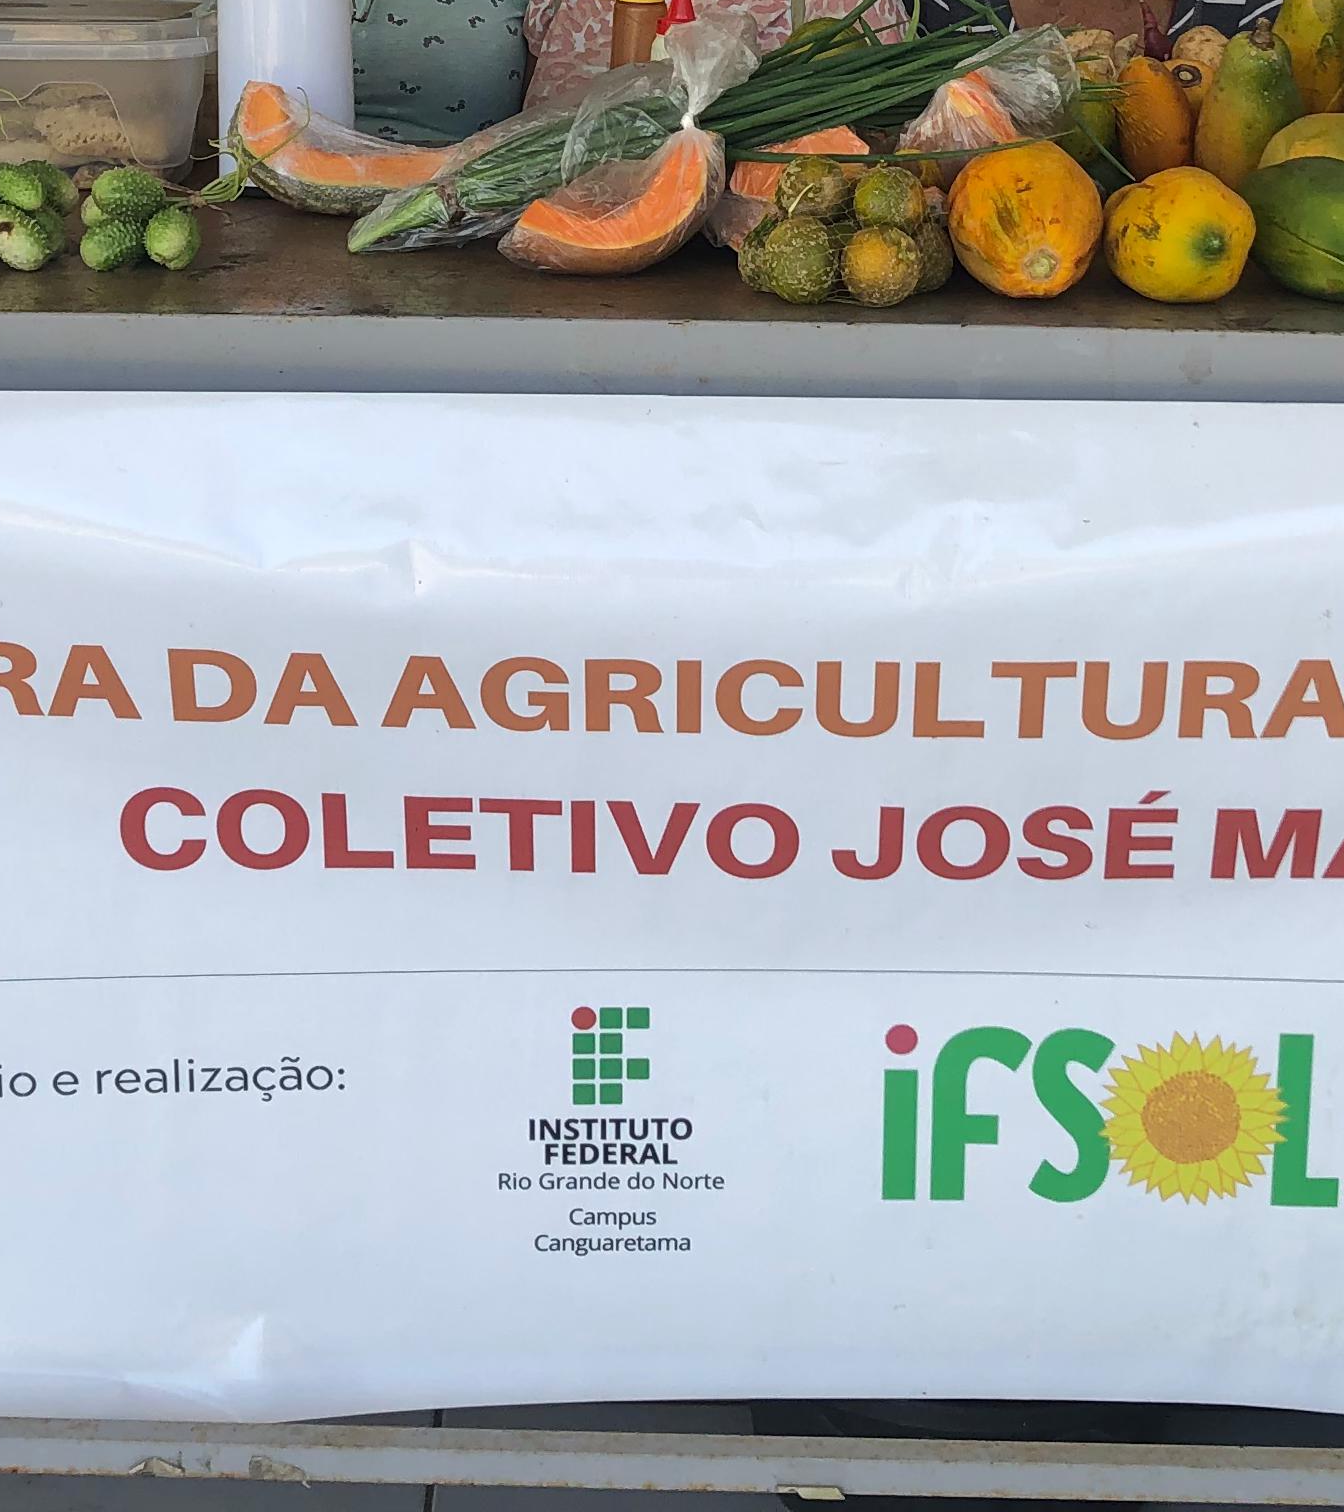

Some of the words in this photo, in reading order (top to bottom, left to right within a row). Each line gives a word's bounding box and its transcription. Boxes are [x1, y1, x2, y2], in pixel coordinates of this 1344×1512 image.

[167, 647, 357, 727] DA
[119, 786, 801, 879] COLETIVO
[831, 790, 1179, 881] JOSÉ
[52, 1070, 80, 1096] e
[96, 1056, 346, 1103] realização:
[528, 1117, 693, 1141] INSTITUTO
[544, 1142, 679, 1166] FEDERAL
[498, 1172, 532, 1191] Rio
[538, 1171, 621, 1191] Grande
[627, 1171, 655, 1190] do
[662, 1172, 726, 1190] Norte
[569, 1207, 657, 1231] Campus
[534, 1234, 692, 1257] Canguaretama
